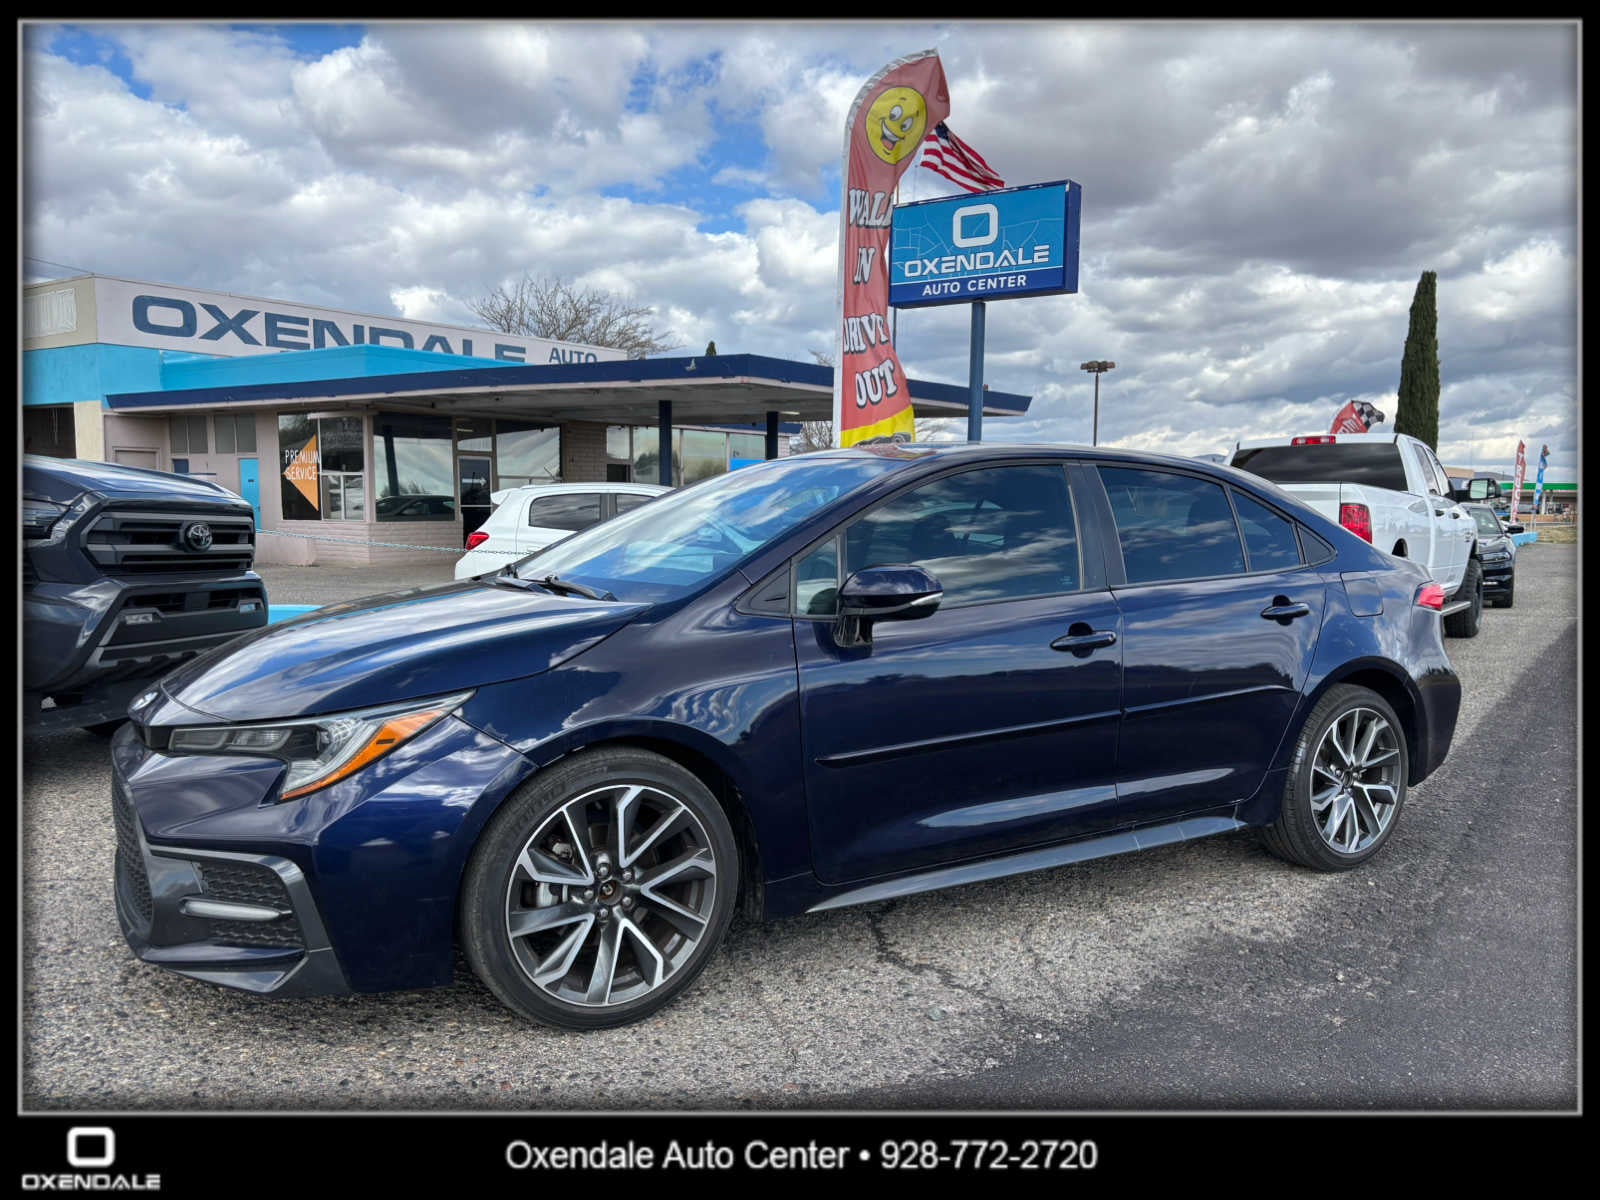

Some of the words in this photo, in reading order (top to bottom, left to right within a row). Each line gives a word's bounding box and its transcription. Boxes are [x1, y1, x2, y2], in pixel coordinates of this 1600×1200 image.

[849, 189, 894, 229] WAL
[853, 247, 876, 284] IN
[904, 244, 1050, 278] OXENDALE
[922, 281, 960, 296] AUTO
[967, 274, 1027, 292] CENTER
[548, 346, 598, 365] AUTO
[855, 358, 899, 408] OUT
[284, 448, 321, 465] PREMIUM
[285, 466, 317, 481] SERVICE
